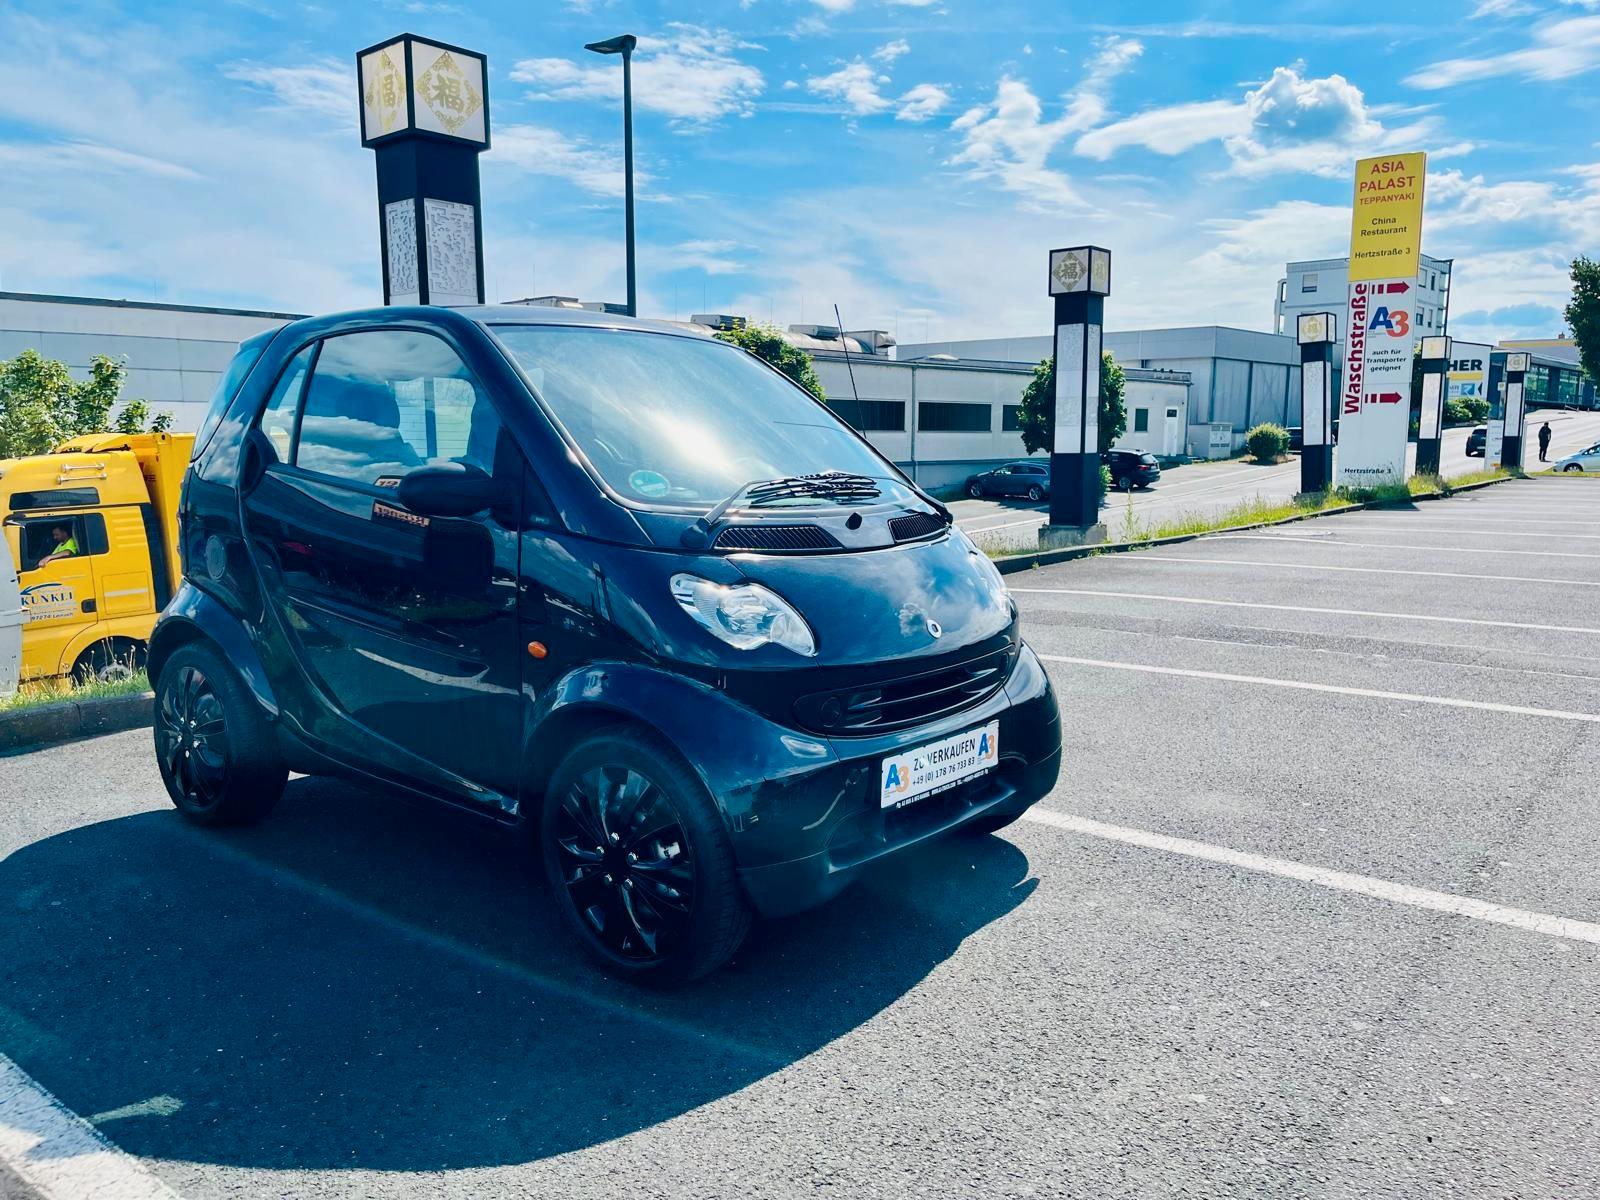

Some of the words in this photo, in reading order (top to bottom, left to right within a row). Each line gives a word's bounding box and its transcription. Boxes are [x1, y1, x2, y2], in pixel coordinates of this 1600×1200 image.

[432, 72, 464, 113] 福
[1371, 160, 1405, 175] ASIA
[1359, 176, 1416, 193] PALAST
[1359, 193, 1415, 205] TEPPANYAKI
[1372, 217, 1397, 226] China
[1360, 226, 1408, 237] Restaurant
[1354, 248, 1403, 259] Hertzstraße
[1405, 247, 1411, 255] 3
[1368, 306, 1410, 338] A3
[1344, 283, 1368, 415] Waschstraße
[1366, 357, 1407, 365] Transporter
[1370, 365, 1402, 373] geeignet
[927, 738, 976, 765] VERKAUFEN
[977, 733, 995, 760] A3
[885, 763, 910, 793] A3
[912, 774, 924, 786] +49
[924, 771, 934, 783] (0)
[935, 767, 947, 778] 178
[948, 764, 956, 774] 76
[957, 759, 967, 770] 733
[967, 756, 975, 766] 83
